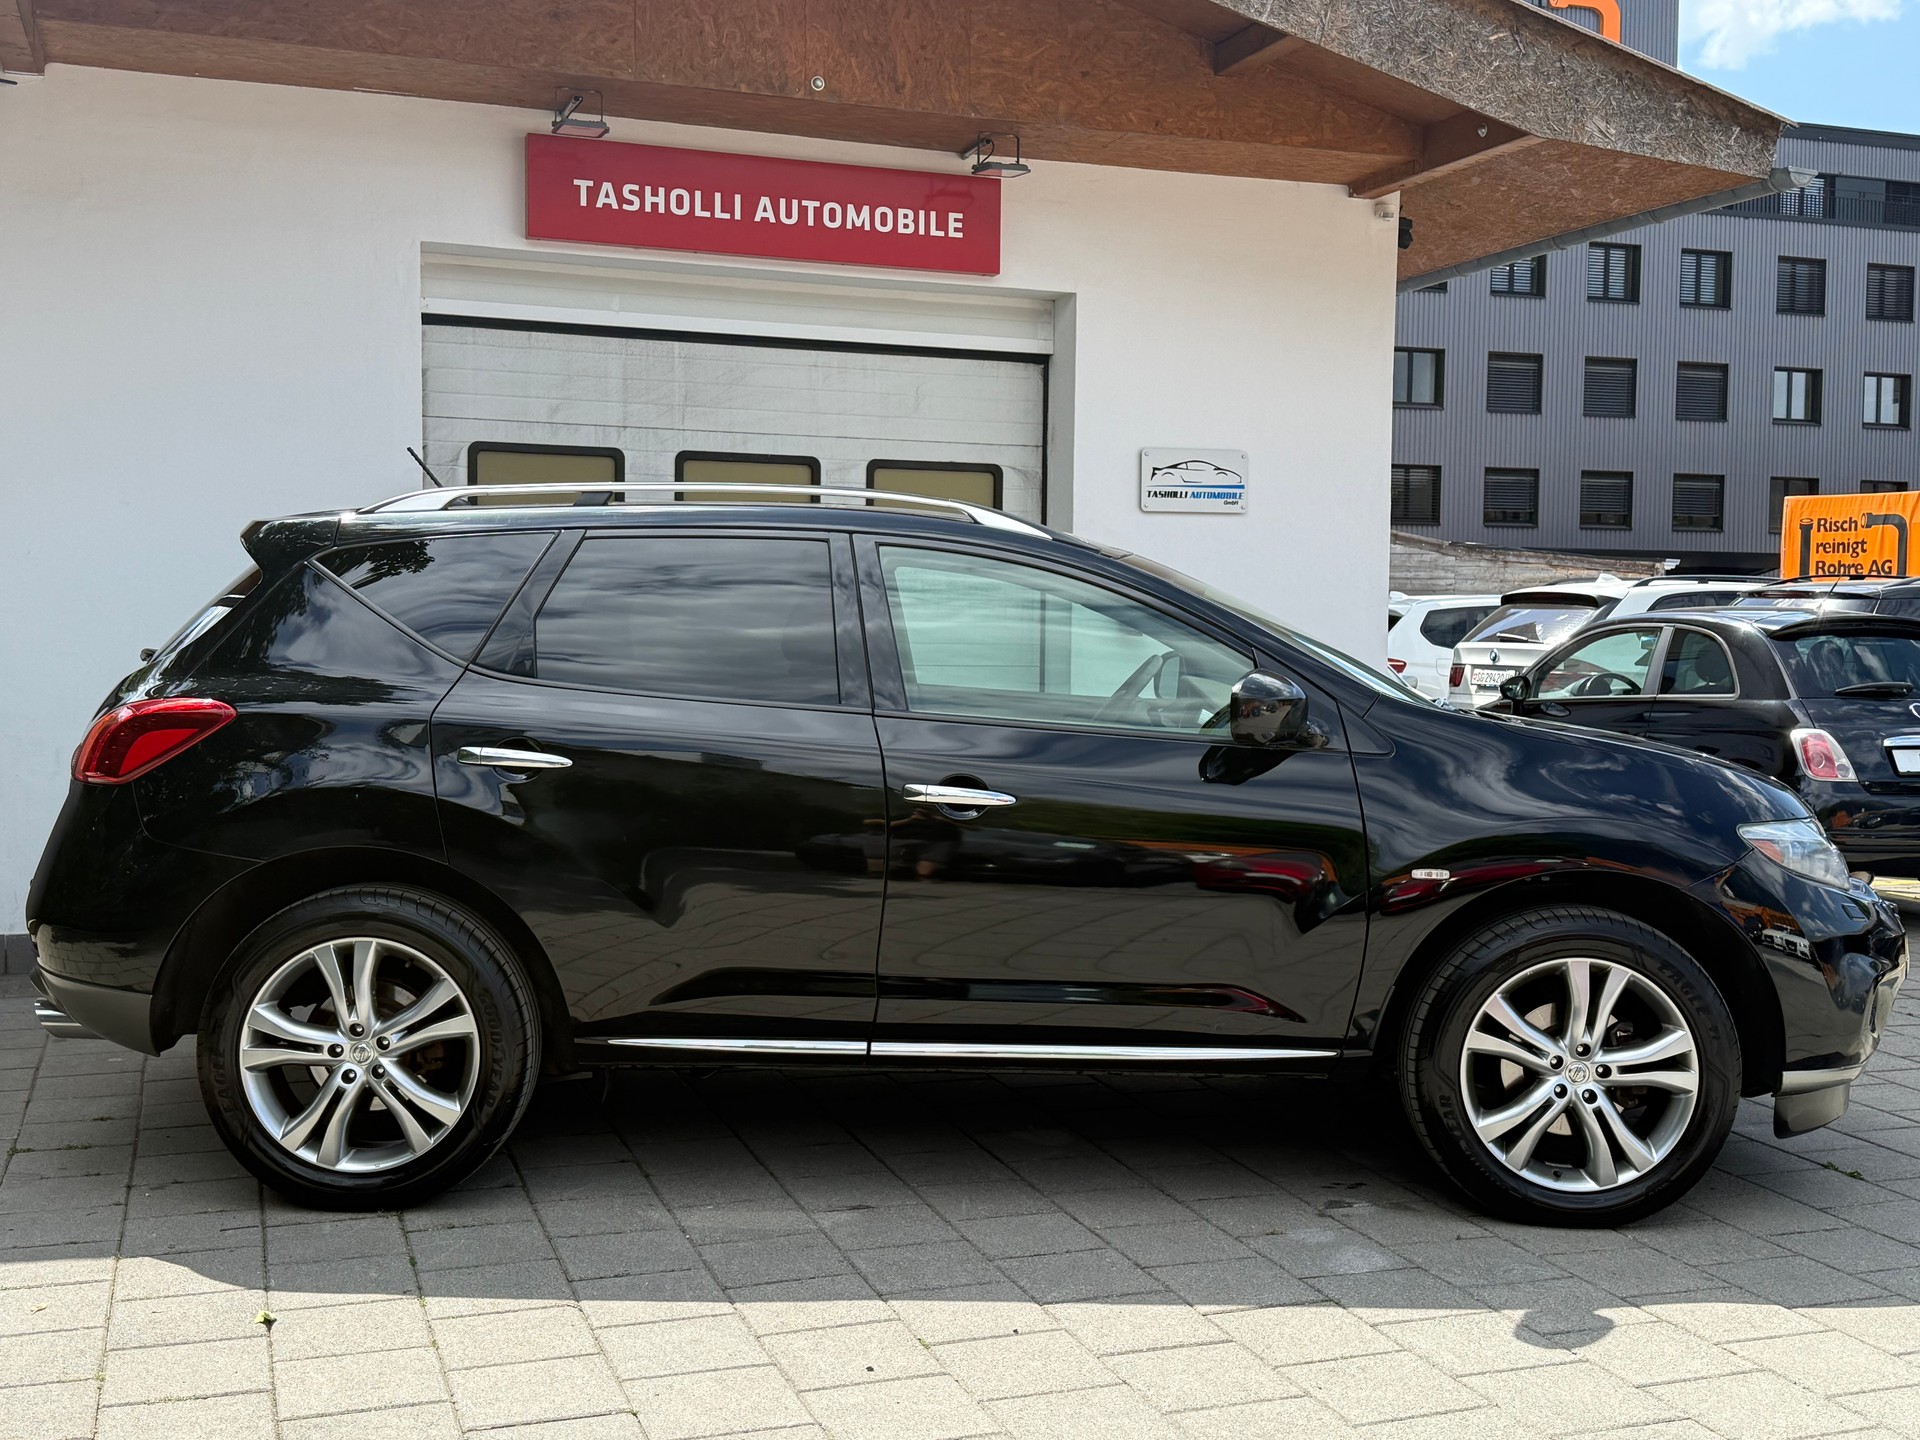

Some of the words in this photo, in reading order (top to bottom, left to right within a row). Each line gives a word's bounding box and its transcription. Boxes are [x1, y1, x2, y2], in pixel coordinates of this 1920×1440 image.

[573, 178, 742, 221] TASHOLLI
[753, 196, 964, 239] AUTOMOBILE
[1146, 490, 1189, 499] TASHOLLI
[1189, 491, 1244, 500] AUTOMOBILE
[1816, 516, 1858, 533] Risch
[1815, 538, 1868, 559] reinigt
[1815, 560, 1864, 575] Rohre
[1868, 559, 1893, 575] AG
